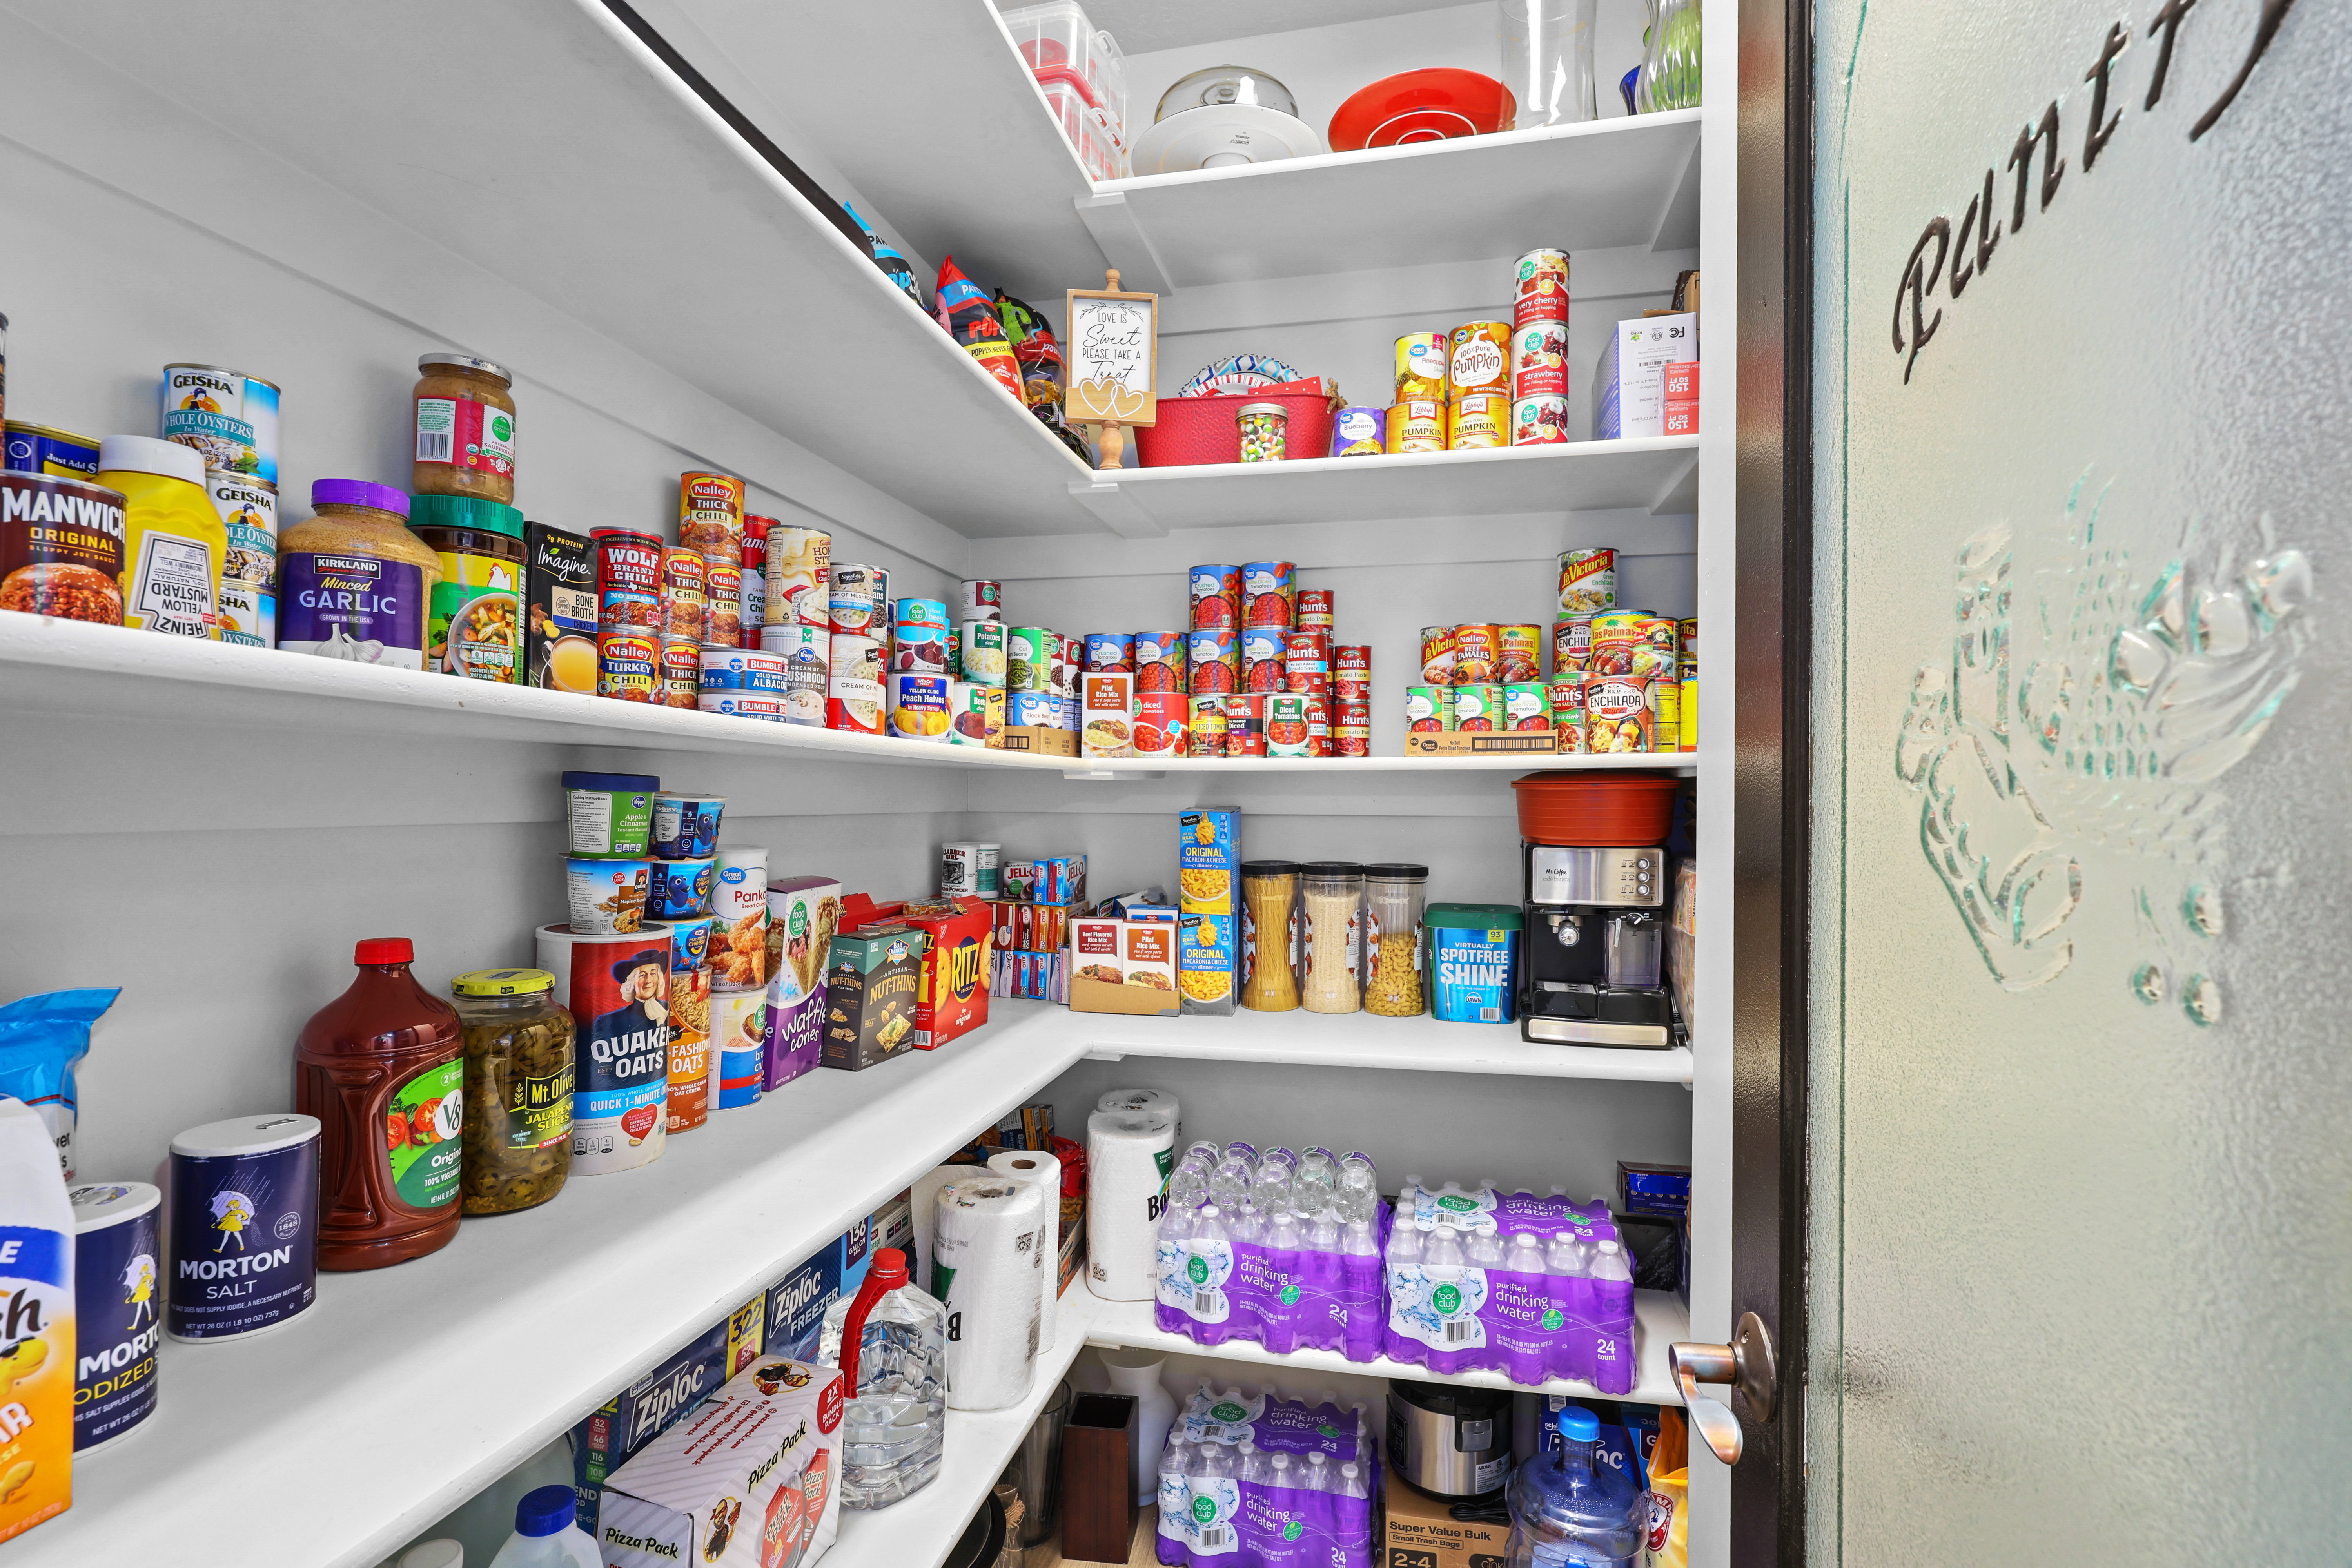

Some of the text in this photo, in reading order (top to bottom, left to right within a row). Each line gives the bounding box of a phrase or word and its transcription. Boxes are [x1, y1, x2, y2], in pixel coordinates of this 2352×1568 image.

[1519, 297, 1558, 310] very cherry
[1098, 313, 1127, 324] LOVE IS
[1083, 324, 1142, 348] Sweet
[971, 345, 1007, 357] POPPED, NEVER
[1082, 348, 1141, 361] PLEASE TAKE A
[1461, 347, 1475, 358] 100%
[1090, 361, 1137, 384] Treat
[1454, 352, 1500, 381] Pumpkin
[1524, 370, 1563, 381] strawberry
[173, 375, 234, 396] GEISHA
[1669, 382, 1689, 392] 150
[1414, 405, 1433, 414] Libby's
[197, 413, 252, 439] OYSTERS
[1402, 428, 1442, 436] PUMPKIN
[47, 452, 85, 470] Just Add
[694, 485, 731, 499] Nalley
[696, 499, 728, 510] THICK
[2, 486, 126, 544] MANWICH
[695, 511, 728, 521] CHILI
[29, 526, 116, 553] ORIGINAL
[547, 534, 584, 550] 9g PROTEIN
[29, 544, 69, 555] SLOPPY
[94, 554, 115, 564] SAUCE
[537, 543, 588, 581] Imagine
[608, 548, 659, 569] WOLF
[318, 558, 377, 572] KIRKLAND
[612, 564, 655, 576] BRAND
[1562, 555, 1608, 588] La Victoria
[156, 573, 190, 584] NATURAL
[321, 576, 373, 592] Minced
[614, 571, 653, 584] CHILI
[151, 583, 208, 604] MUSTARD
[575, 594, 594, 608] BONE
[626, 594, 655, 603] BEANS
[161, 599, 203, 615] YELLOW
[299, 590, 396, 615] GARLIC
[1299, 601, 1328, 613] Hunt's
[571, 606, 593, 621] BROTH
[160, 617, 204, 635] HEINZ
[573, 620, 593, 632] CHICKEN
[977, 633, 1001, 641] Potatoes
[610, 646, 650, 660] Nalley
[1287, 646, 1320, 659] Hunt's
[1457, 651, 1490, 660] TAMALES
[606, 661, 651, 673] TURKEY
[751, 659, 781, 670] BUMBLE
[611, 676, 646, 685] CHILI
[924, 695, 945, 704] Halves
[1590, 695, 1641, 708] ENCHILADA
[1602, 706, 1623, 714] Sauce
[1186, 847, 1223, 857] ORIGINAL
[734, 890, 766, 903] Panko
[1441, 947, 1508, 964] SPOTFREE
[951, 942, 980, 992] RITZ
[1440, 962, 1508, 987] SHINE
[869, 976, 916, 1005] NUT-THINS
[960, 985, 973, 994] CRACKERS
[781, 995, 826, 1038] waffle
[955, 1010, 971, 1026] original
[590, 1026, 670, 1064] QUAKER
[790, 1030, 820, 1053] cones
[615, 1050, 664, 1078] OATS
[532, 1074, 573, 1103] Mt. Olive
[590, 1089, 660, 1112] QUICK 1-MINUTE
[443, 1096, 461, 1131] V8
[537, 1115, 570, 1131] SLICES
[278, 1214, 297, 1225] TRUSTED
[278, 1220, 298, 1231] 1848
[279, 1227, 296, 1237] QUALITY
[180, 1245, 290, 1280] MORTON
[206, 1279, 257, 1299] SALT
[253, 1283, 303, 1306] NECESSARY NUTRIENT
[1436, 1290, 1456, 1301] food
[1496, 1282, 1528, 1294] purified
[775, 1271, 822, 1330] Ziploc
[1438, 1296, 1456, 1307] club
[1496, 1292, 1549, 1310] drinking
[790, 1287, 838, 1337] FREEZER
[1496, 1303, 1536, 1321] water
[731, 1303, 762, 1343] 322
[1597, 1339, 1616, 1354] 24
[1597, 1353, 1616, 1361] count
[637, 1363, 705, 1436] Ziploc
[822, 1399, 842, 1423] BUNDLE
[824, 1410, 840, 1429] PACK
[747, 1419, 807, 1494] Pizza Pack
[1389, 1521, 1492, 1541] Super Value Bulk
[605, 1527, 679, 1559] Pizza Pack
[1392, 1534, 1460, 1548] Small Trash Bags
